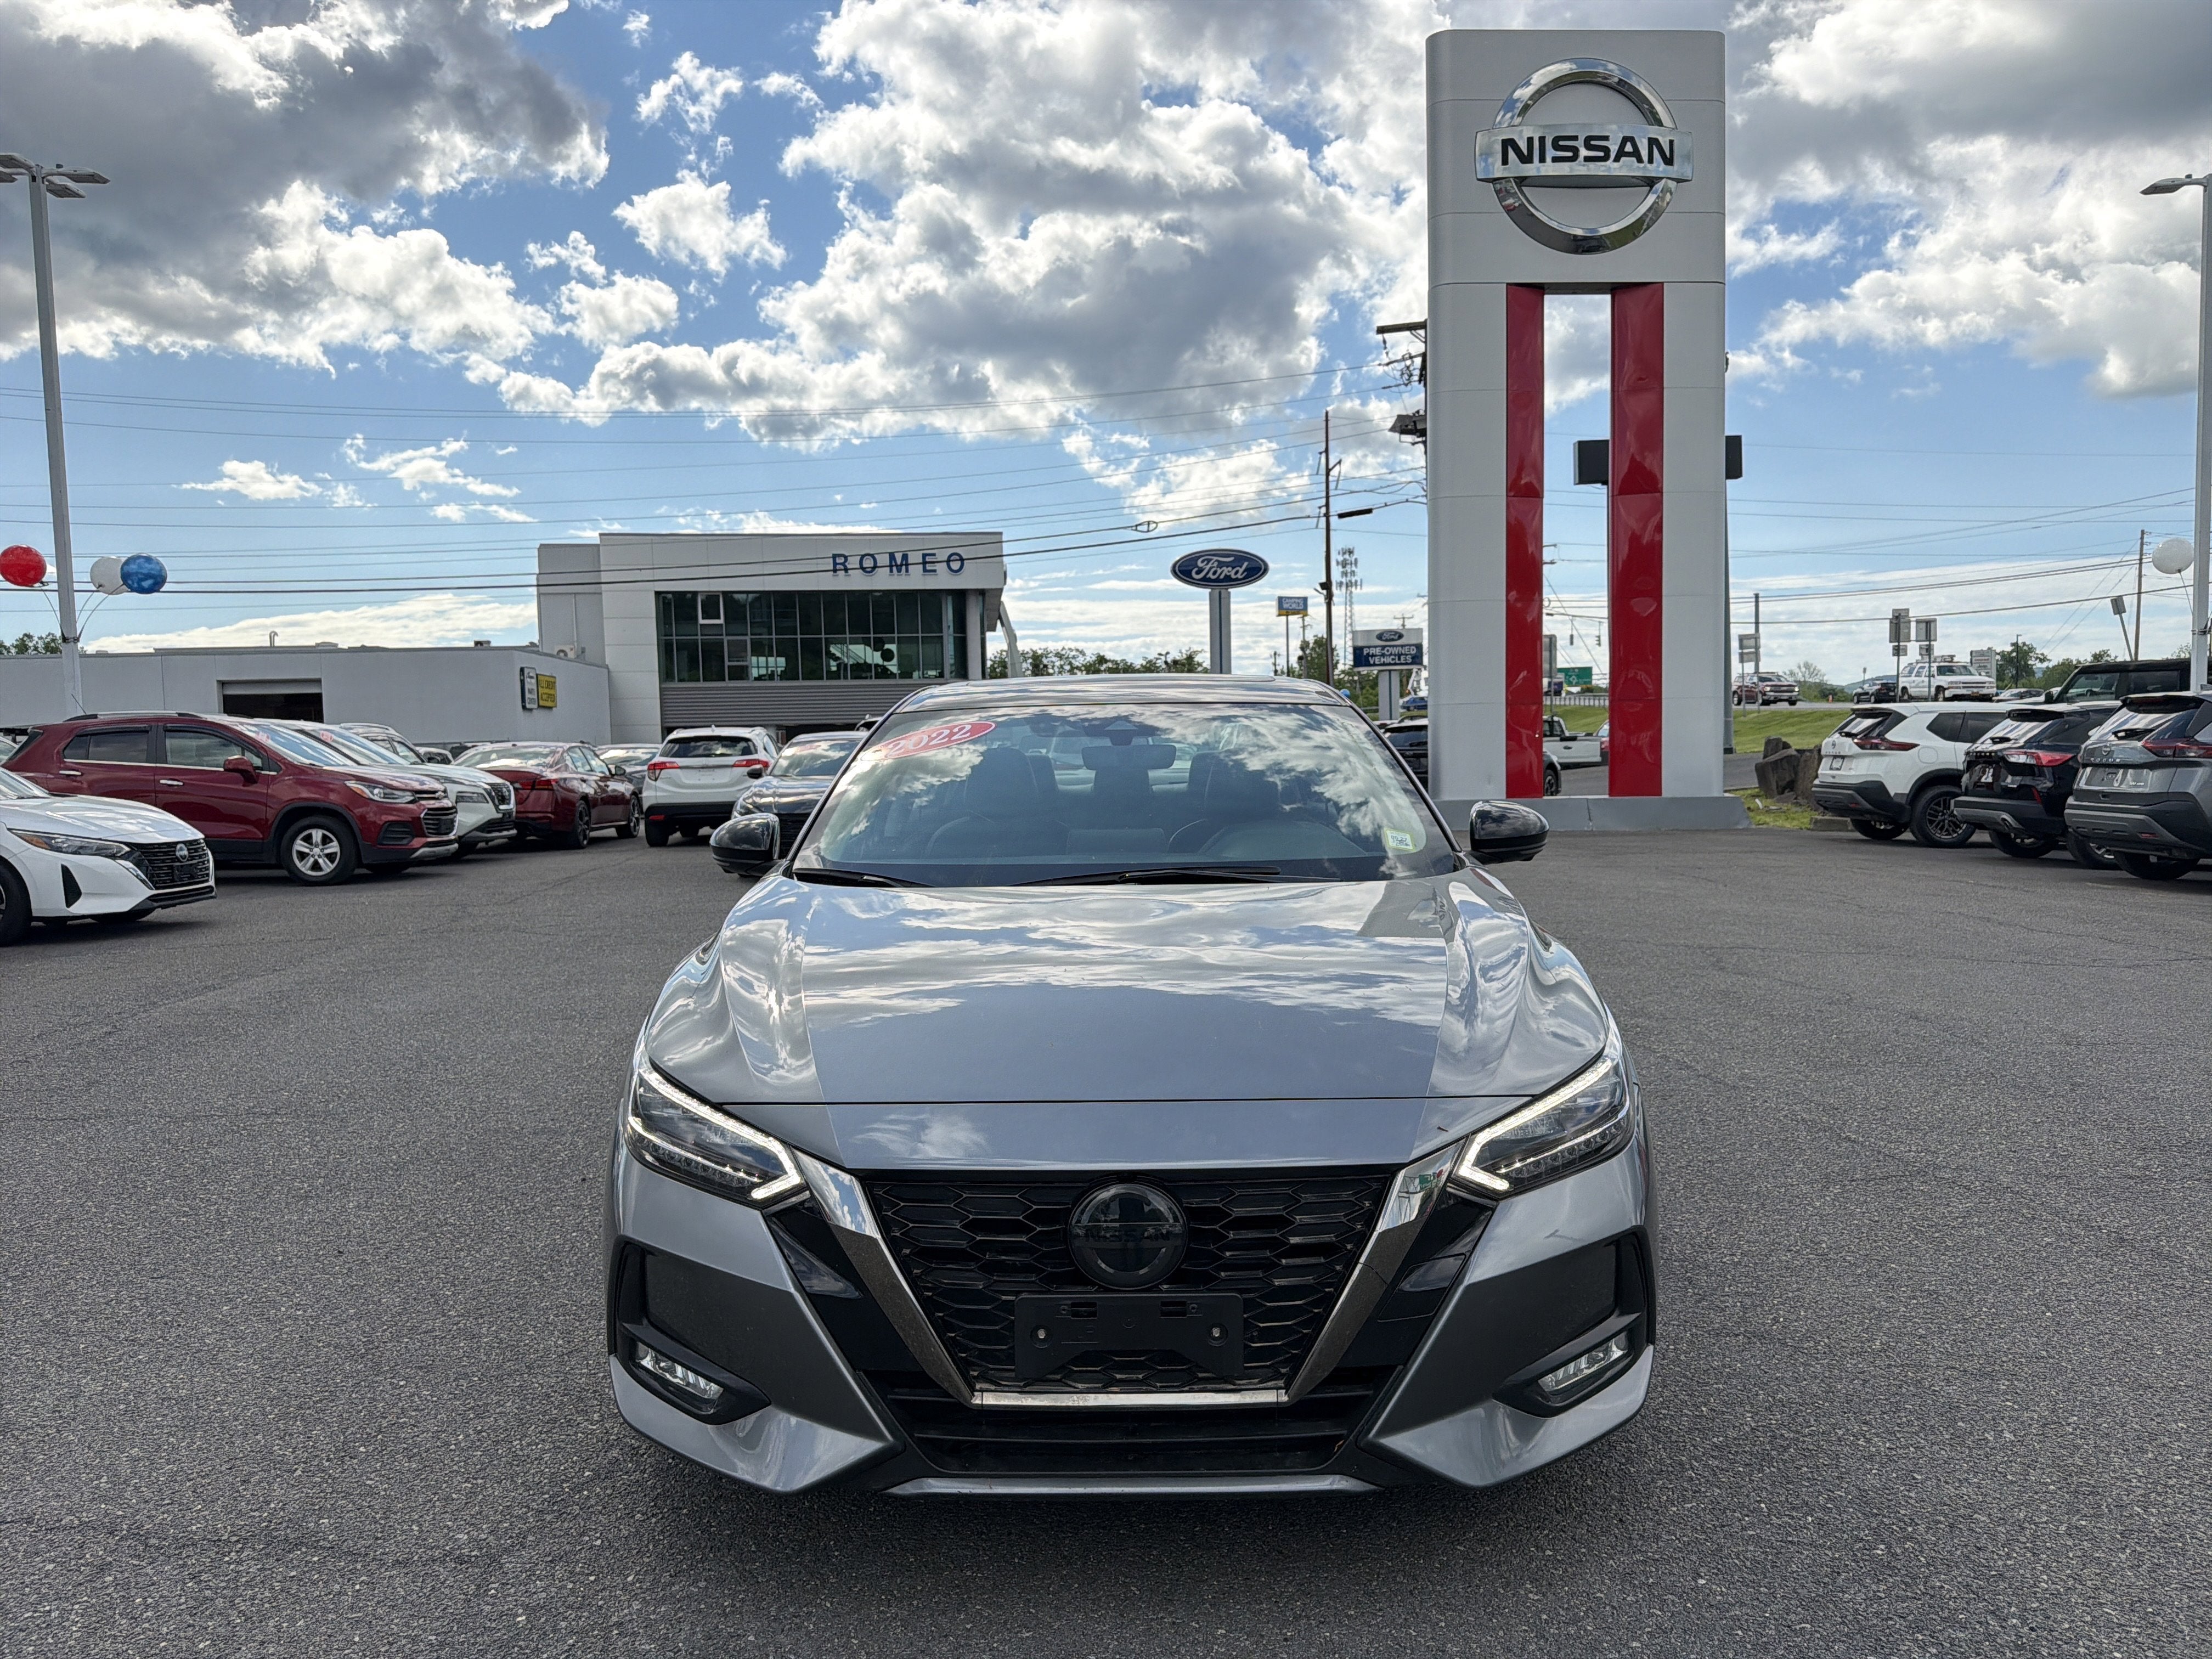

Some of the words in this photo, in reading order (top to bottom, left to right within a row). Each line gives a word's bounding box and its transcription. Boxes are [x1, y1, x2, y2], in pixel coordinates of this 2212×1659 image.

[1501, 135, 1675, 167] NISSAN
[832, 552, 965, 574] ROMEO
[1191, 556, 1249, 579] Ford
[1363, 646, 1417, 655] PRE-OWNED
[1369, 655, 1412, 664] VEHICLES
[886, 724, 972, 756] 2022
